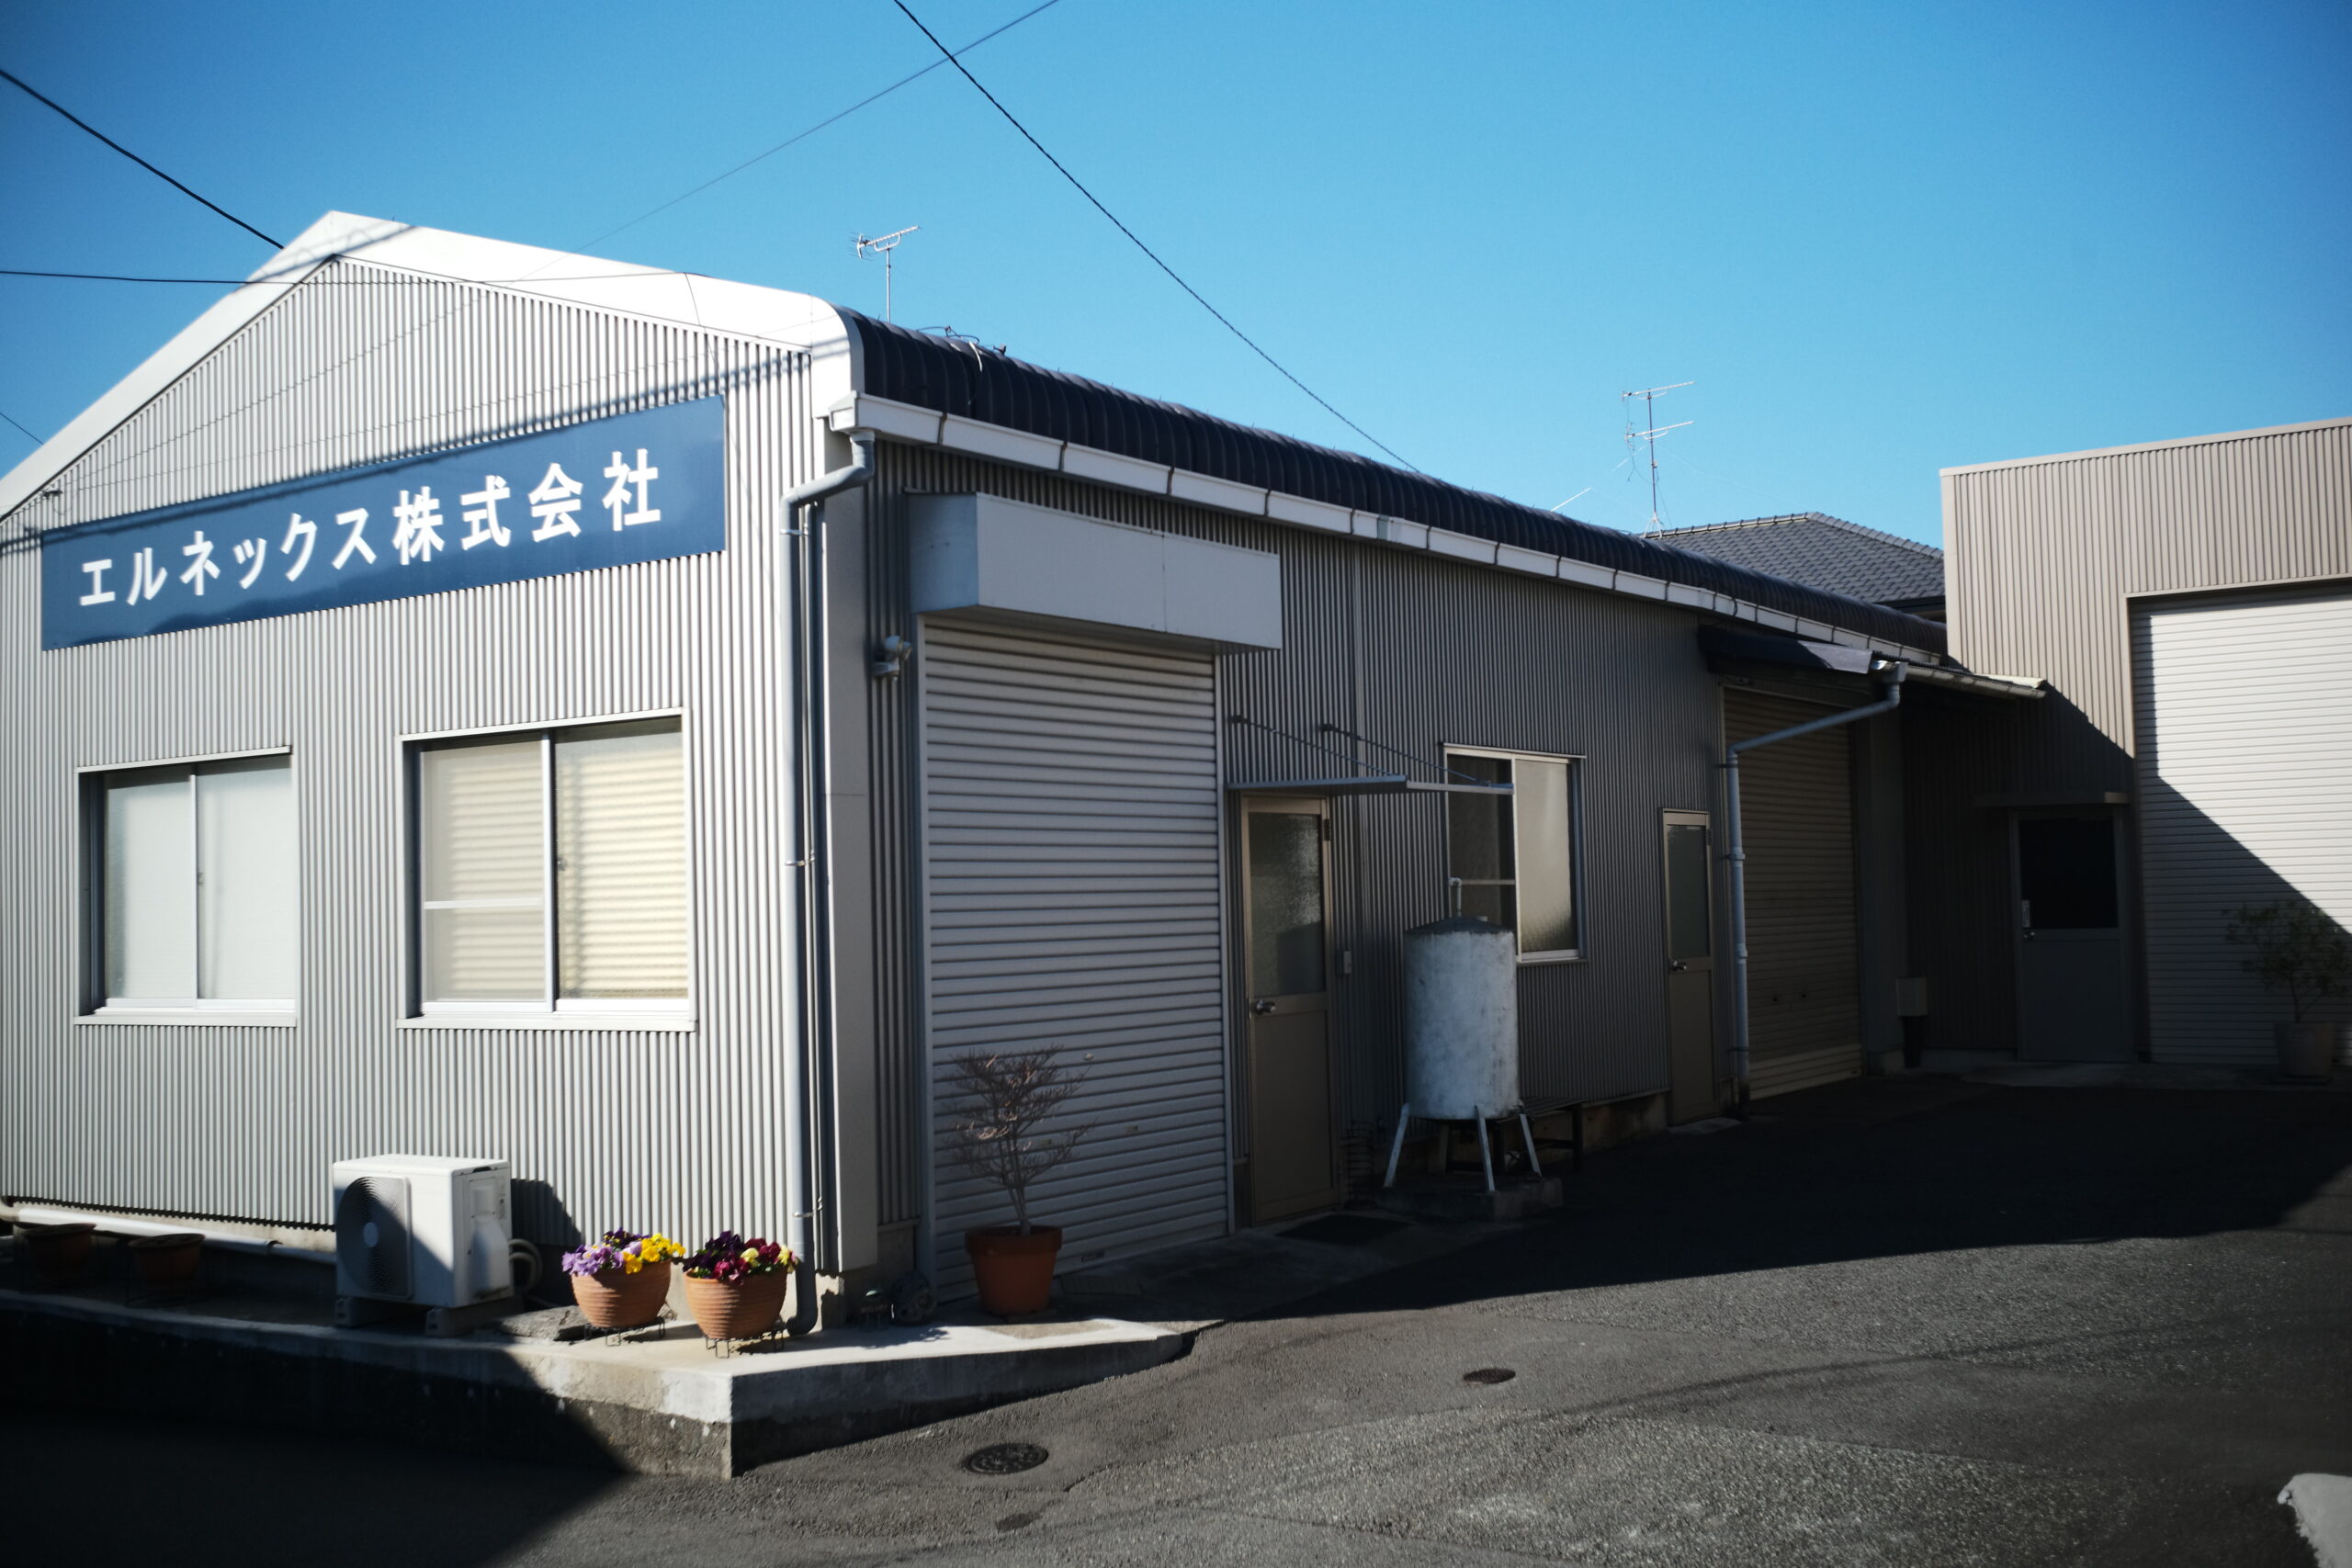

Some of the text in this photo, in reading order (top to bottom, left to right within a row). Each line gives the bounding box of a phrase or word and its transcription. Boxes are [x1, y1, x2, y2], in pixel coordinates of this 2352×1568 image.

[79, 448, 662, 606] エルネックス株式会社
